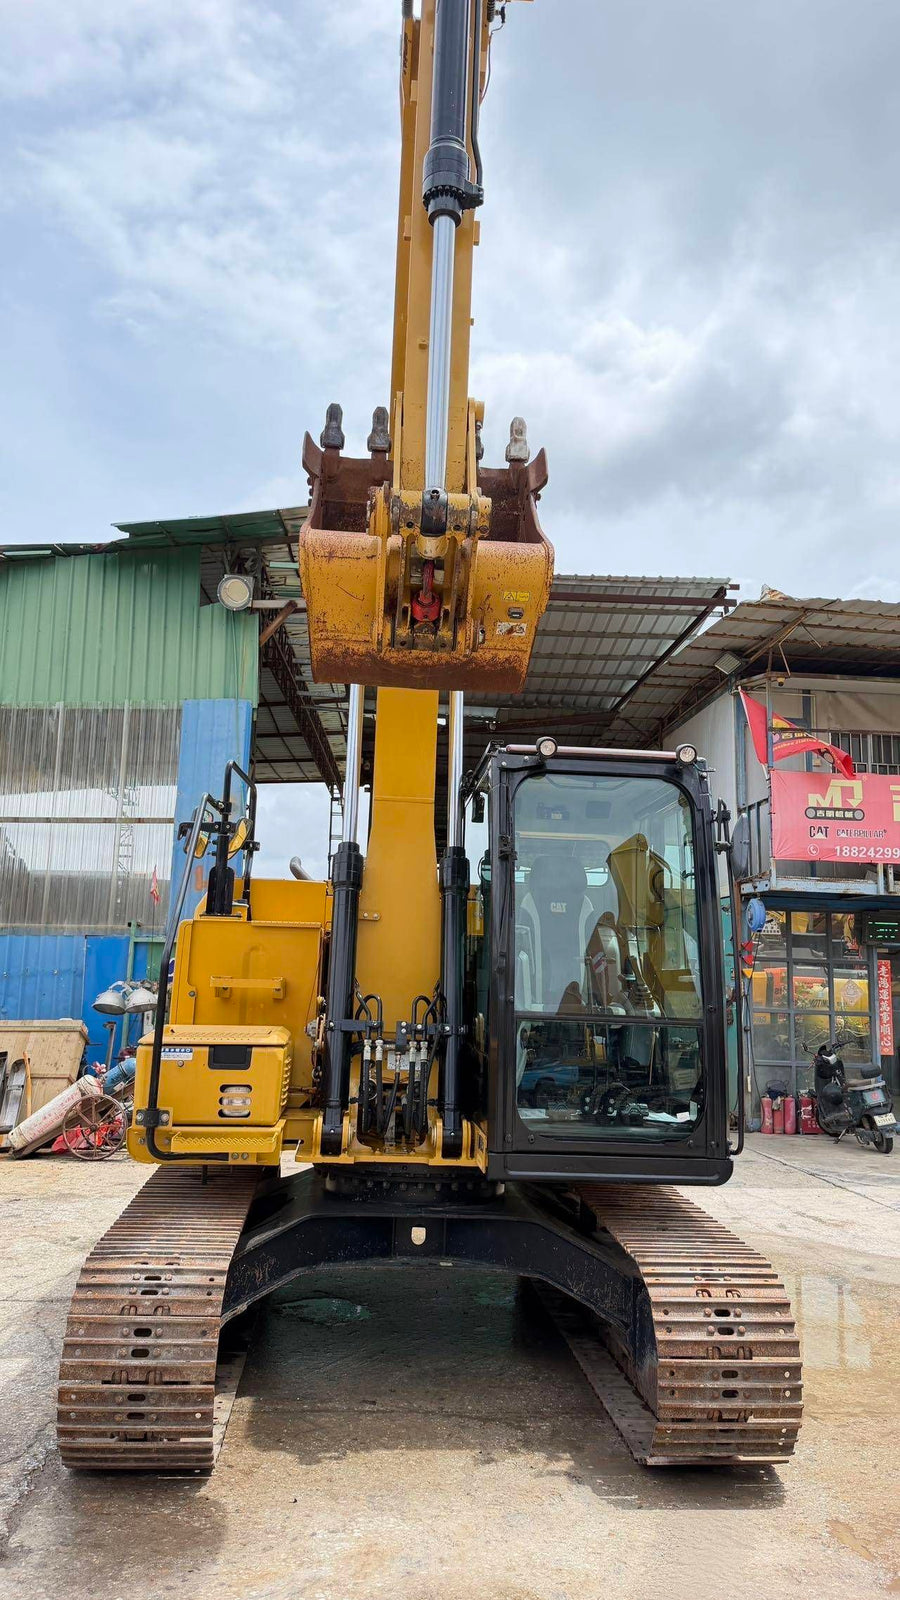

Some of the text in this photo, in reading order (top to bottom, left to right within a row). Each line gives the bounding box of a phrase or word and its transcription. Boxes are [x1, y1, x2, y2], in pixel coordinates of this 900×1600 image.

[809, 825, 884, 838] CAT CATERPILLAR
[835, 846, 900, 858] 18824299
[551, 902, 567, 912] CAT
